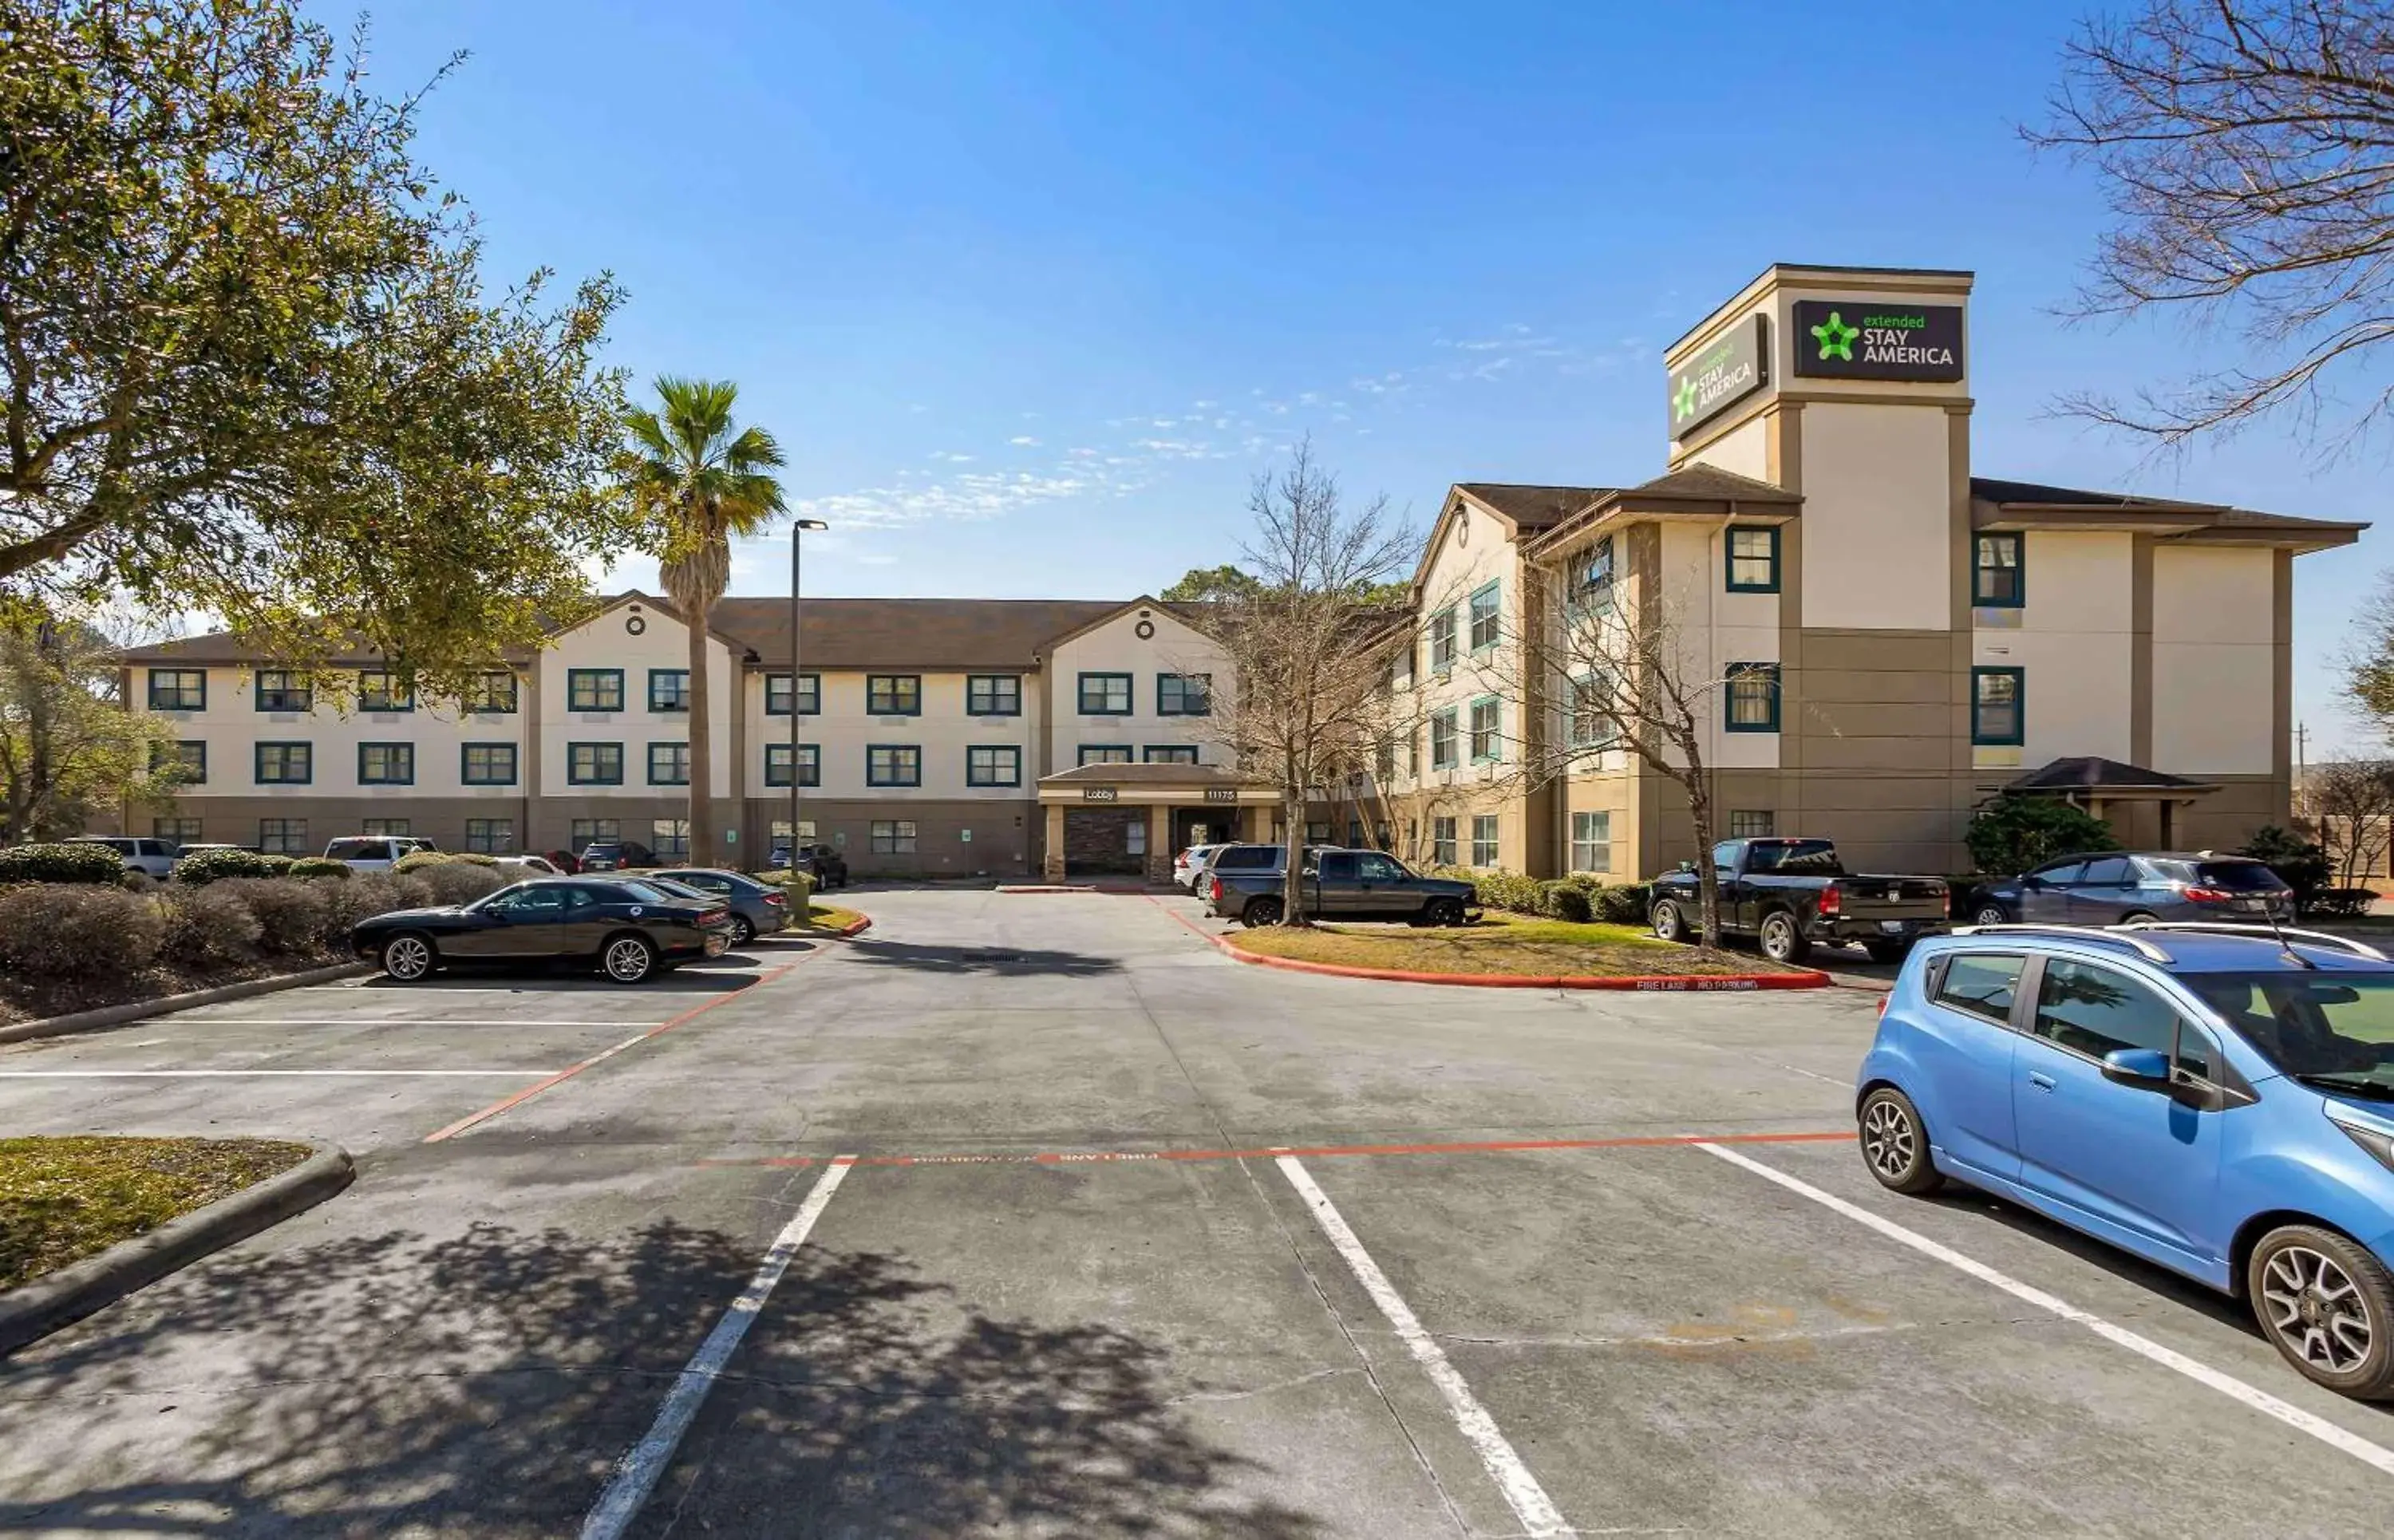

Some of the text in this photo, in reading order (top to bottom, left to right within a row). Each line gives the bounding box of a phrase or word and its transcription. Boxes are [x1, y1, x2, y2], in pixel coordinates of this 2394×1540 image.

[1863, 314, 1925, 328] extended
[1863, 328, 1909, 346] STAY
[1863, 346, 1954, 365] AMERICA
[1699, 362, 1724, 393] STAY
[1699, 361, 1752, 409] AMERICA
[1086, 790, 1115, 800] Lobby
[1208, 791, 1235, 800] 11175
[1637, 980, 1660, 990] FIRE
